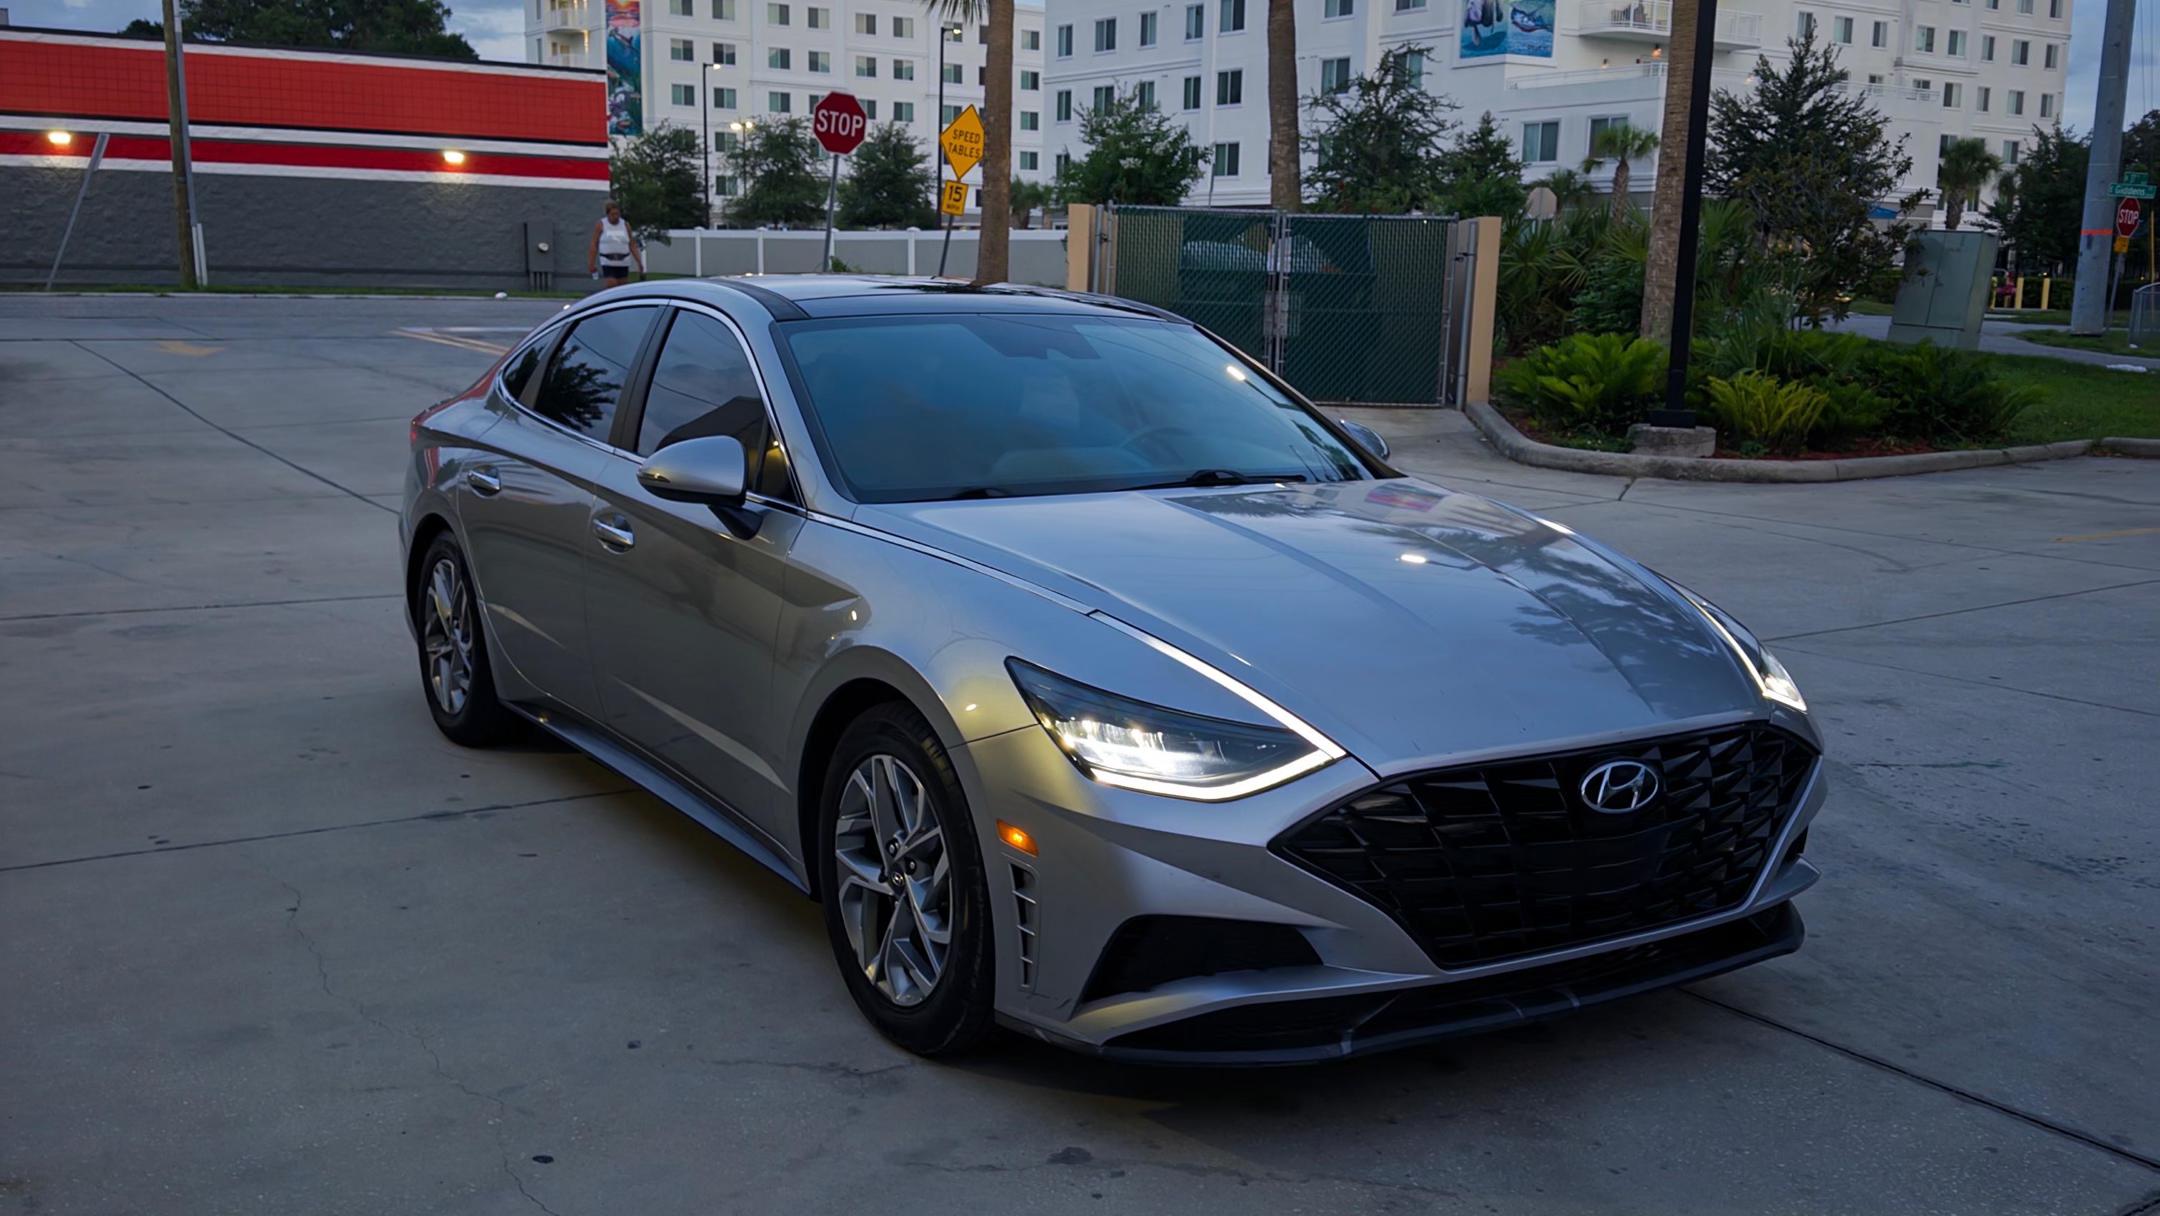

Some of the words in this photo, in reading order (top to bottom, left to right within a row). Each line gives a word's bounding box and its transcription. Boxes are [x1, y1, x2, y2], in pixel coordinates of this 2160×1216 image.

[816, 109, 863, 137] STOP
[952, 129, 981, 144] SPEED
[948, 142, 981, 159] TABLES
[948, 185, 962, 202] 15
[2119, 209, 2139, 225] STOP
